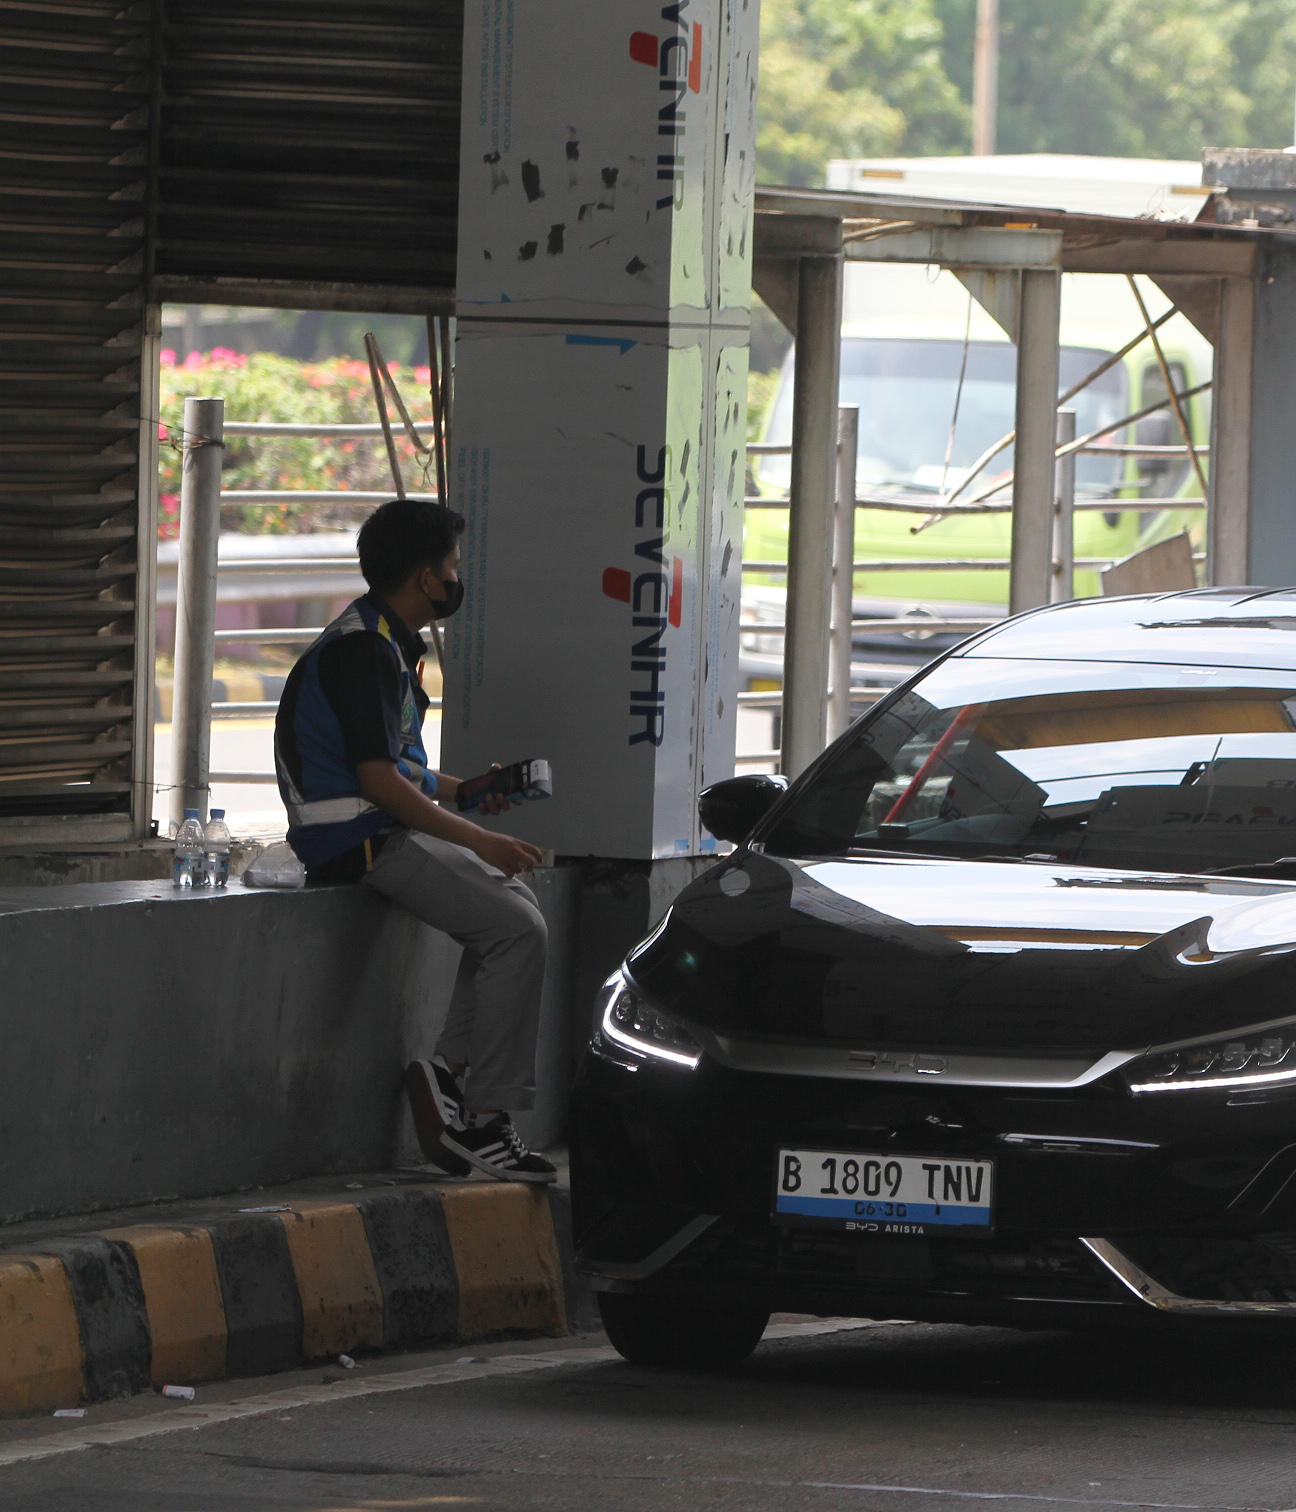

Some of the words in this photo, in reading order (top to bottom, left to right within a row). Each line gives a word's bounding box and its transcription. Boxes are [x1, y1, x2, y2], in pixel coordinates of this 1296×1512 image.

[629, 444, 675, 747] SEVENHR
[846, 1050, 949, 1076] BYD
[782, 1155, 802, 1193] B
[821, 1158, 903, 1198] 1809
[922, 1163, 984, 1203] TNV
[885, 1224, 924, 1235] ARISTA
